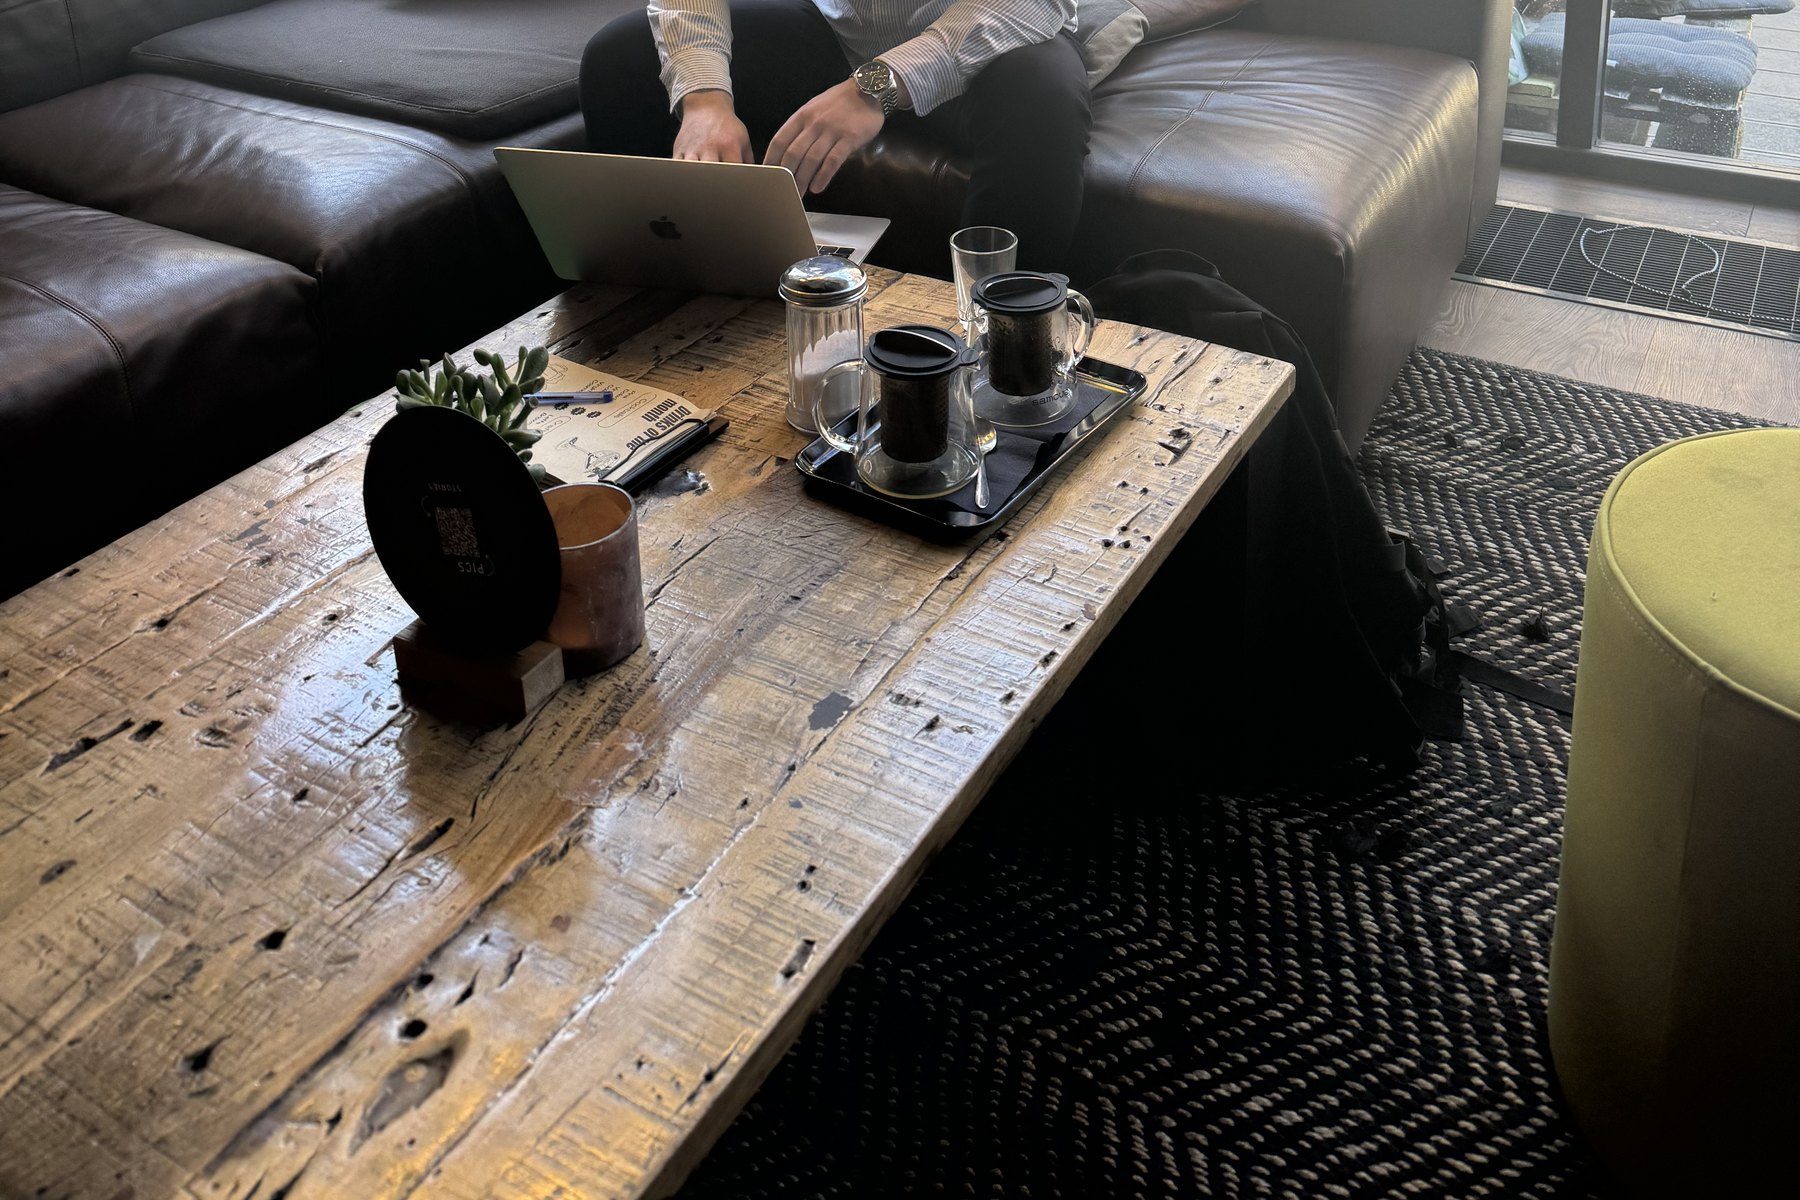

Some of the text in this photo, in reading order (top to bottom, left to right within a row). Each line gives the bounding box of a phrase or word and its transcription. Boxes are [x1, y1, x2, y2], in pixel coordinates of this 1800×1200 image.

[641, 398, 678, 422] month
[655, 405, 692, 431] Drinks
[643, 427, 659, 442] of
[457, 561, 485, 575] PICS
